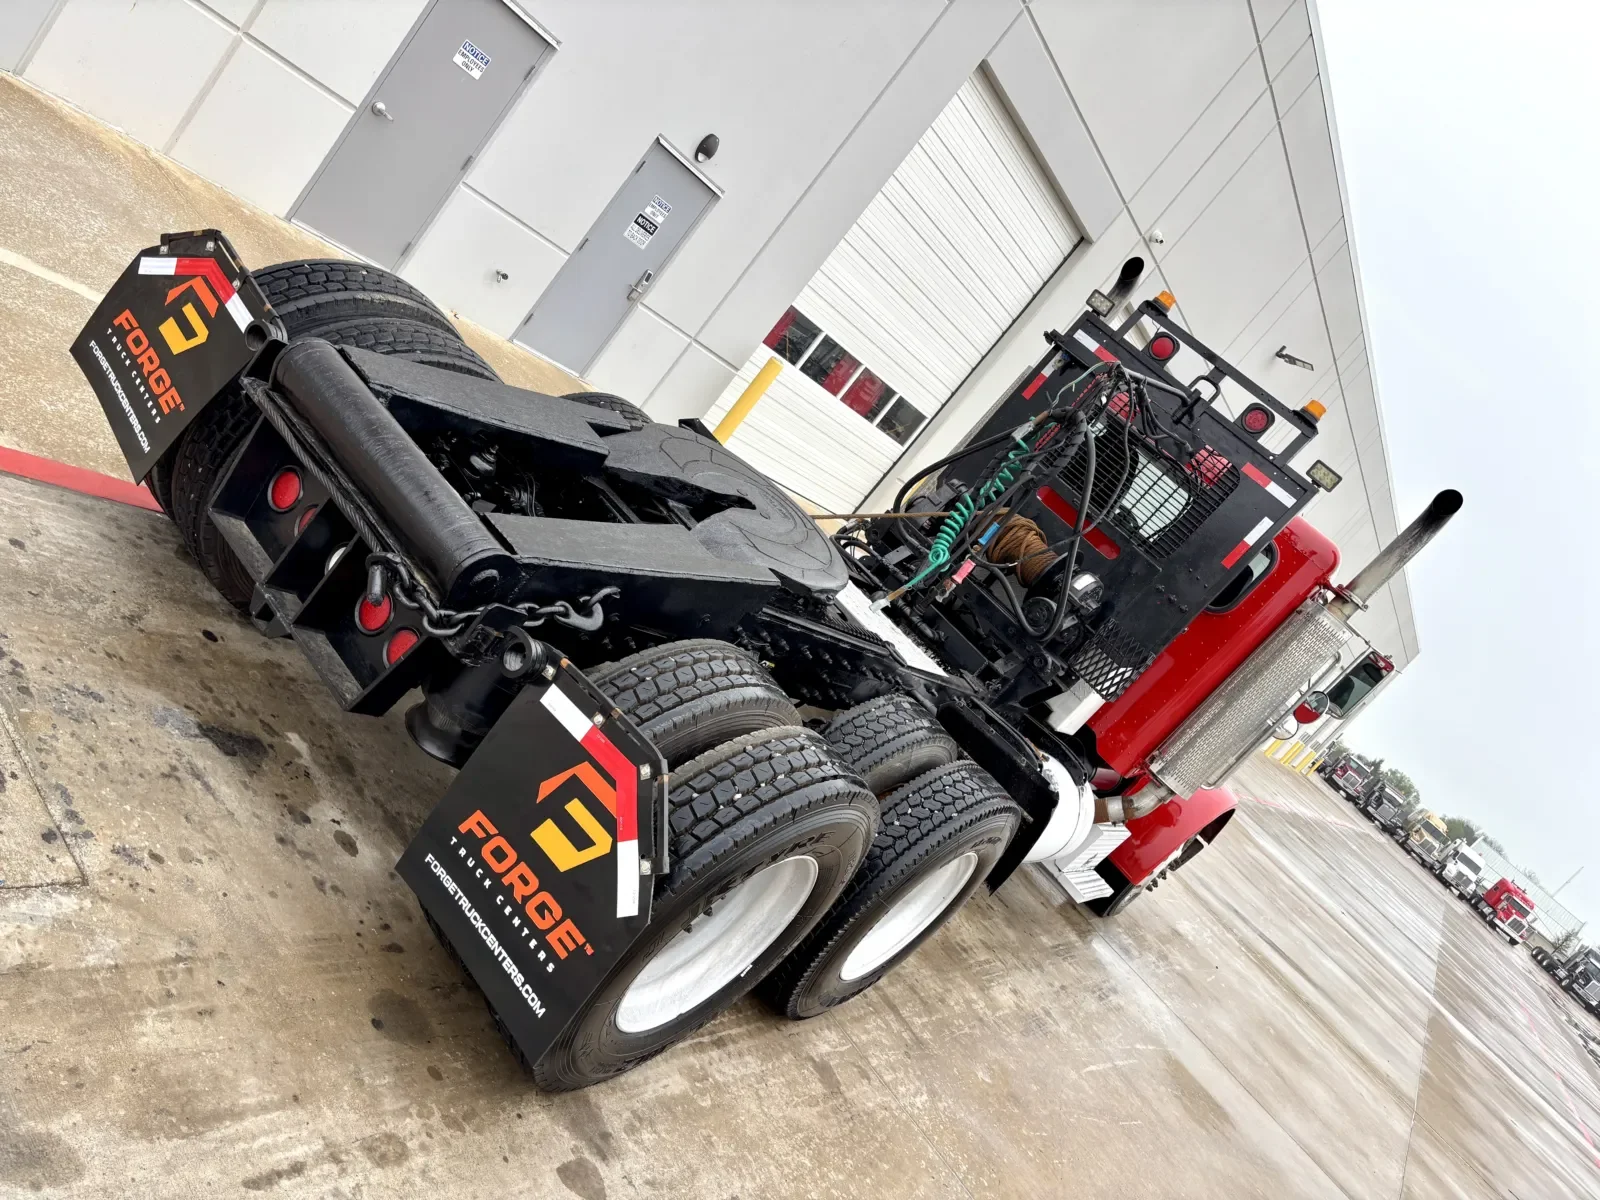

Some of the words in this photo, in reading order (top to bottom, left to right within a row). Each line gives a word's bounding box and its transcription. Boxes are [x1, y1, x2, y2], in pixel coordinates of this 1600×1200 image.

[458, 49, 484, 72] EMPLOYEES
[461, 60, 474, 72] ONLY
[463, 42, 489, 65] NOTICE
[637, 215, 656, 233] NOTICE
[89, 339, 150, 454] FORGETRUCKCENTERS.COM
[106, 327, 130, 367] TRUCK
[131, 370, 161, 424] CENTERS
[113, 308, 182, 415] FORGE
[450, 836, 492, 889] TRUCK
[495, 894, 556, 973] CENTERS
[458, 809, 587, 960] FORGE
[424, 853, 547, 1019] FORGETRUCKCENTERS.COM
